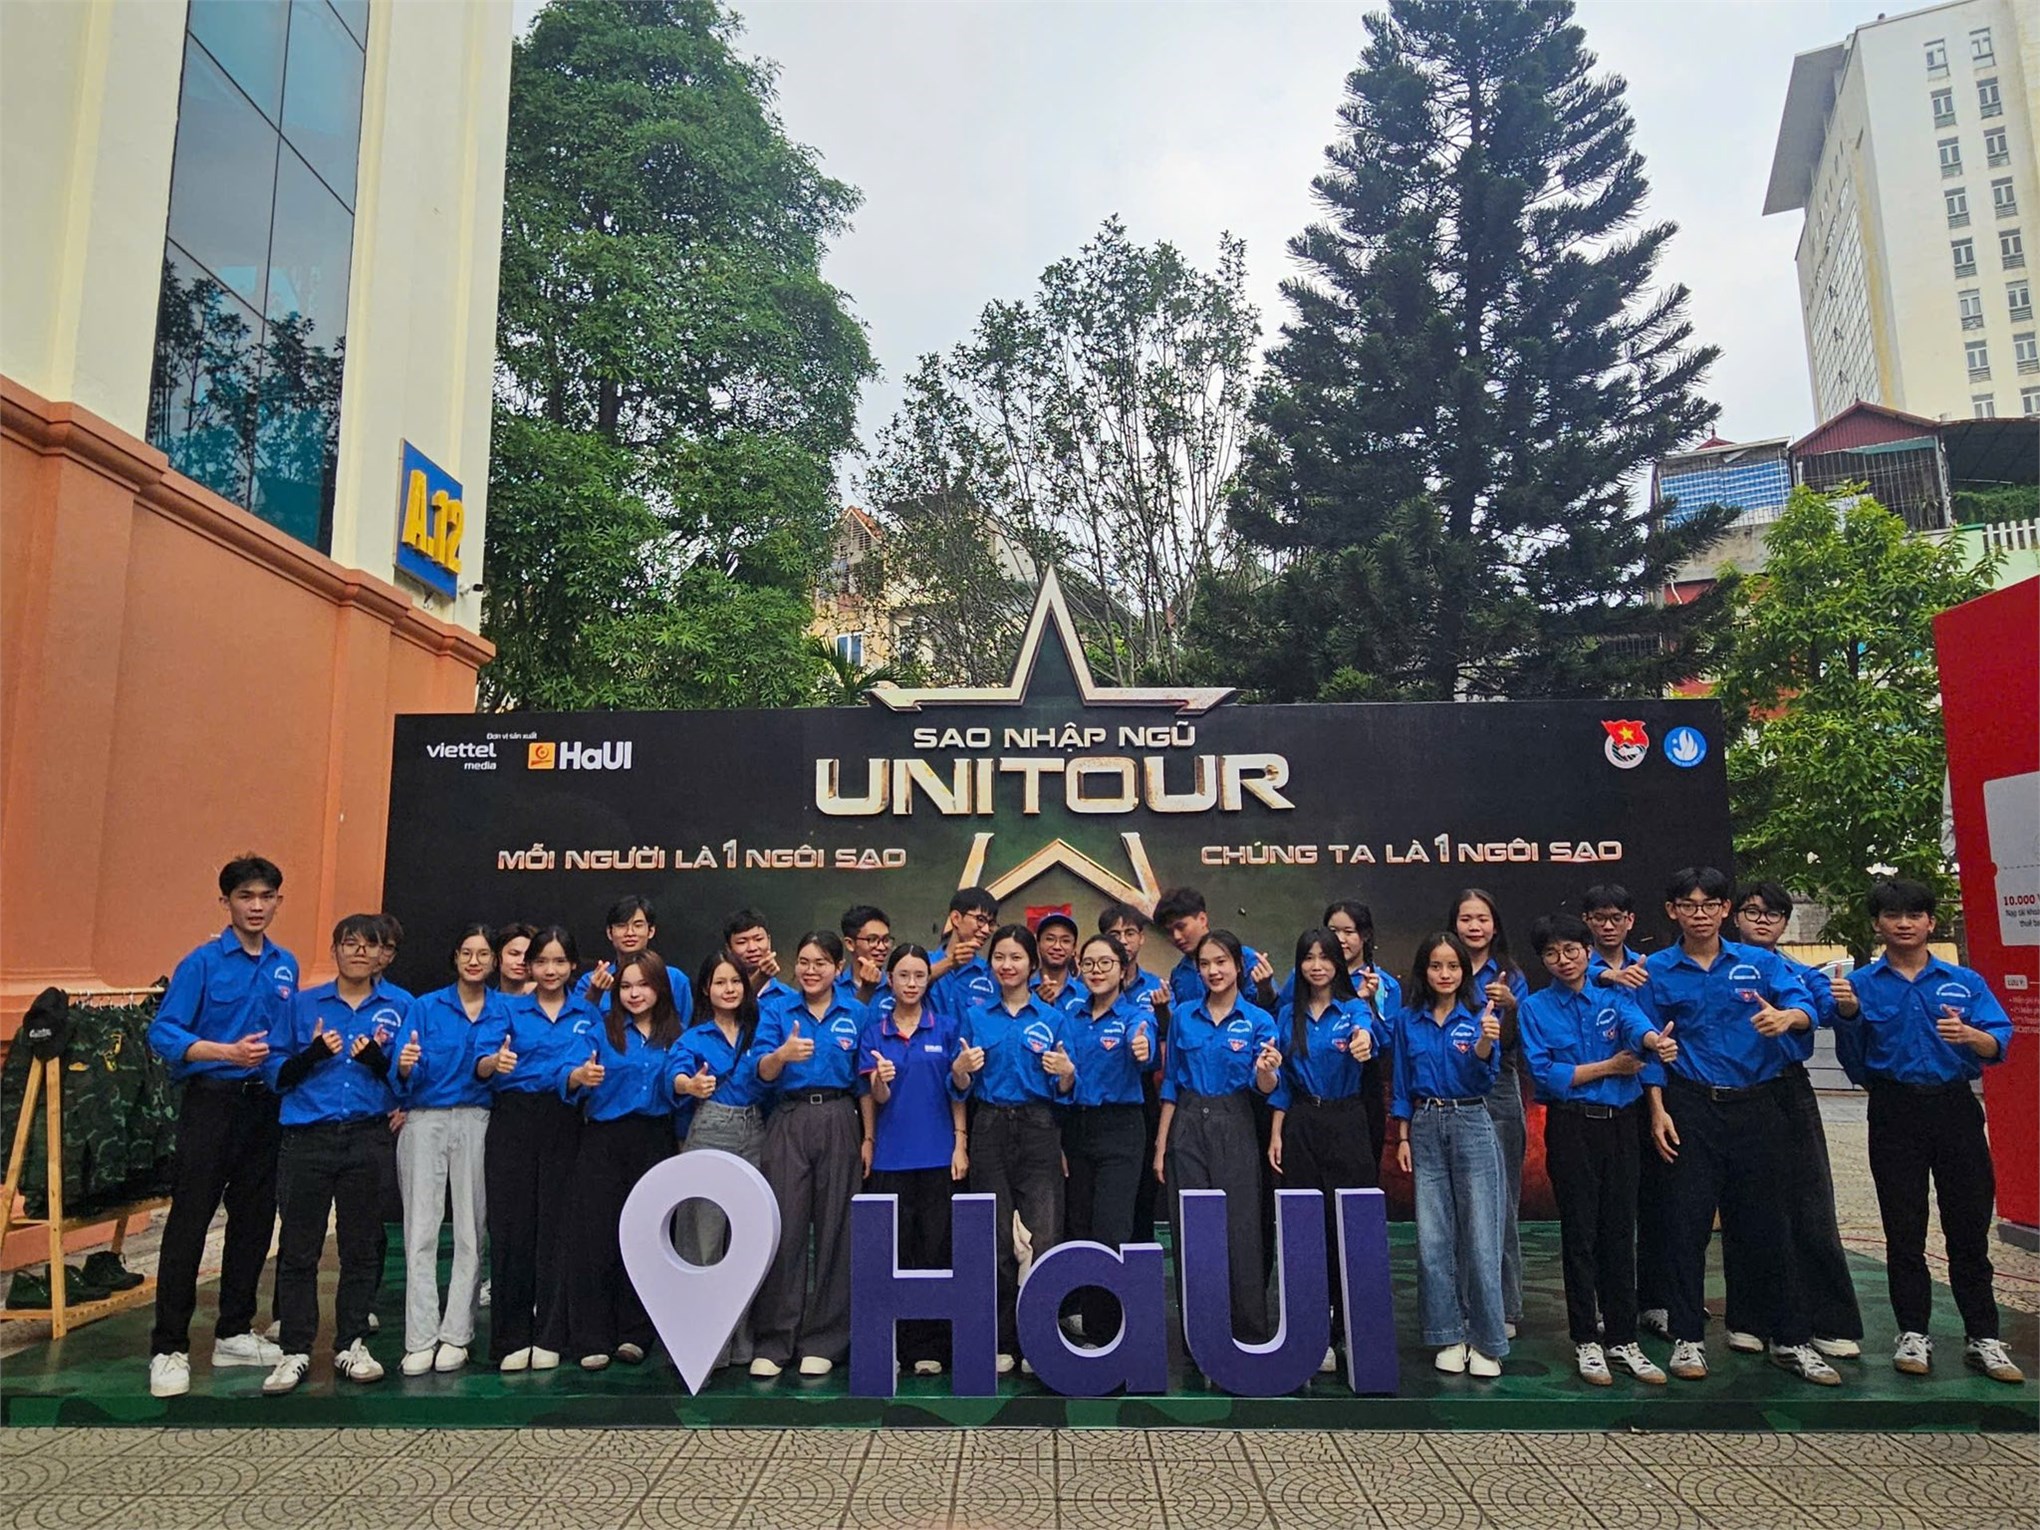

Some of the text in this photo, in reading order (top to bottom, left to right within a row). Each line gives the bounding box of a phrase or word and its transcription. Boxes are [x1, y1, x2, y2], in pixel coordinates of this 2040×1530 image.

[402, 470, 465, 574] A.12
[426, 742, 497, 758] viettel
[486, 732, 501, 740] Đơn
[913, 721, 1196, 752] SAO NHẬP NGŨ
[464, 760, 497, 771] media
[559, 741, 633, 770] HaUI
[815, 753, 1296, 815] UNITOUR
[497, 839, 907, 870] MỖI NGƯỜI LÀ 1 NGÔI SAO
[1200, 833, 1623, 865] CHÚNG TA LÀ 1 NGÔI SAO
[2003, 894, 2036, 906] 10.000
[848, 1187, 1399, 1398] HaUI
